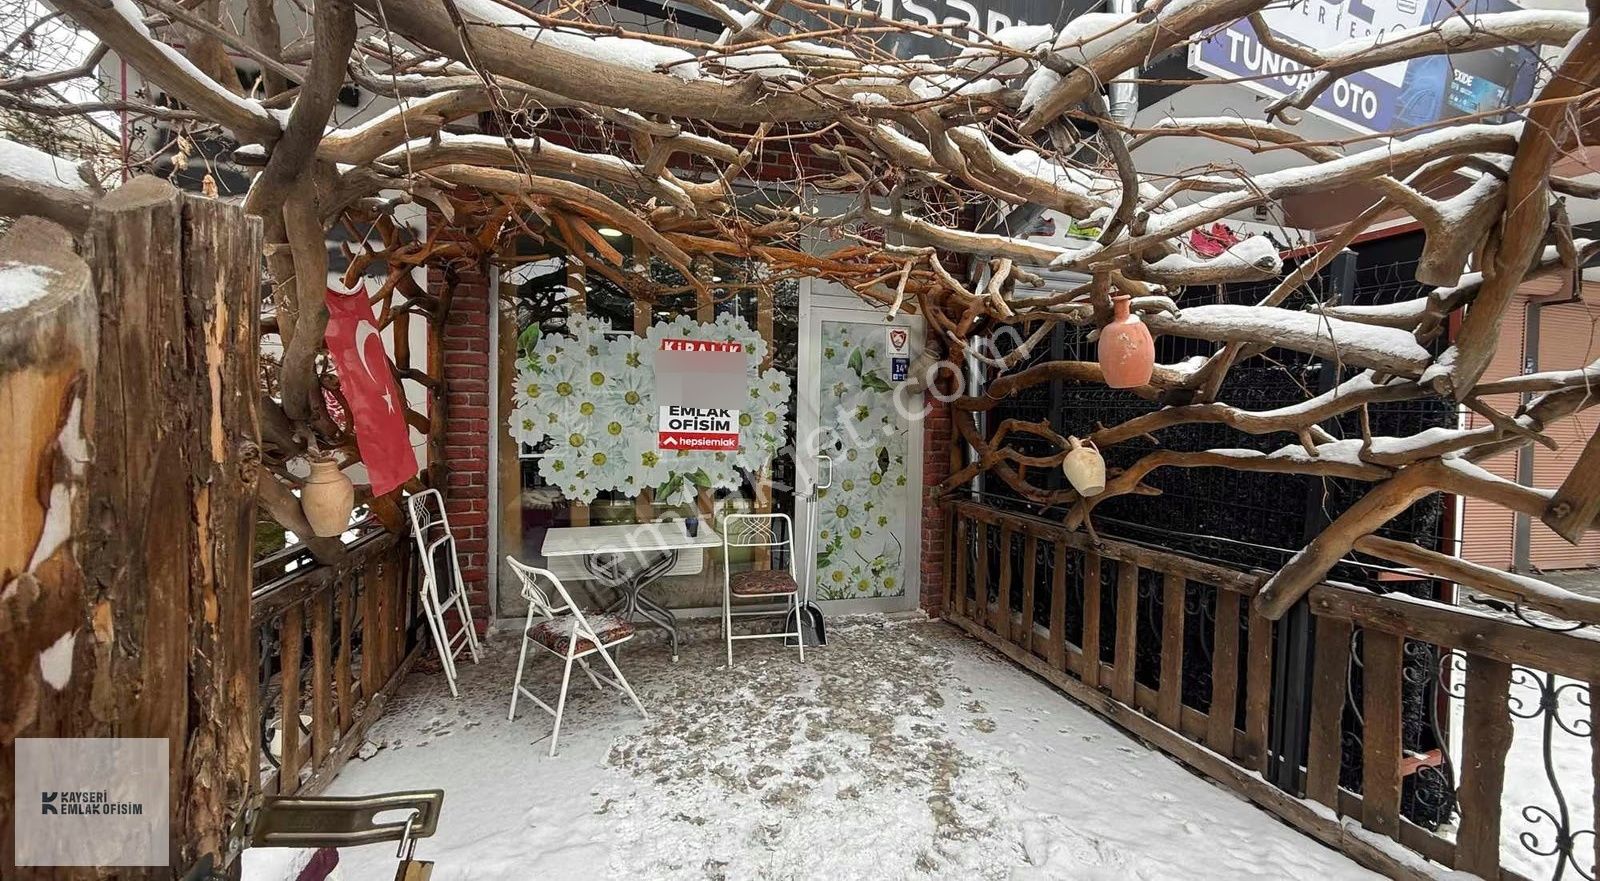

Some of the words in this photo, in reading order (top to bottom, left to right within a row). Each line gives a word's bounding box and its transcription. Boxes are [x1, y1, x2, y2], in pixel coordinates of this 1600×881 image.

[1226, 28, 1322, 98] TUNCA
[1333, 78, 1377, 119] OTO
[668, 416, 730, 431] OFİSİM
[679, 435, 735, 447] hepsiemlak
